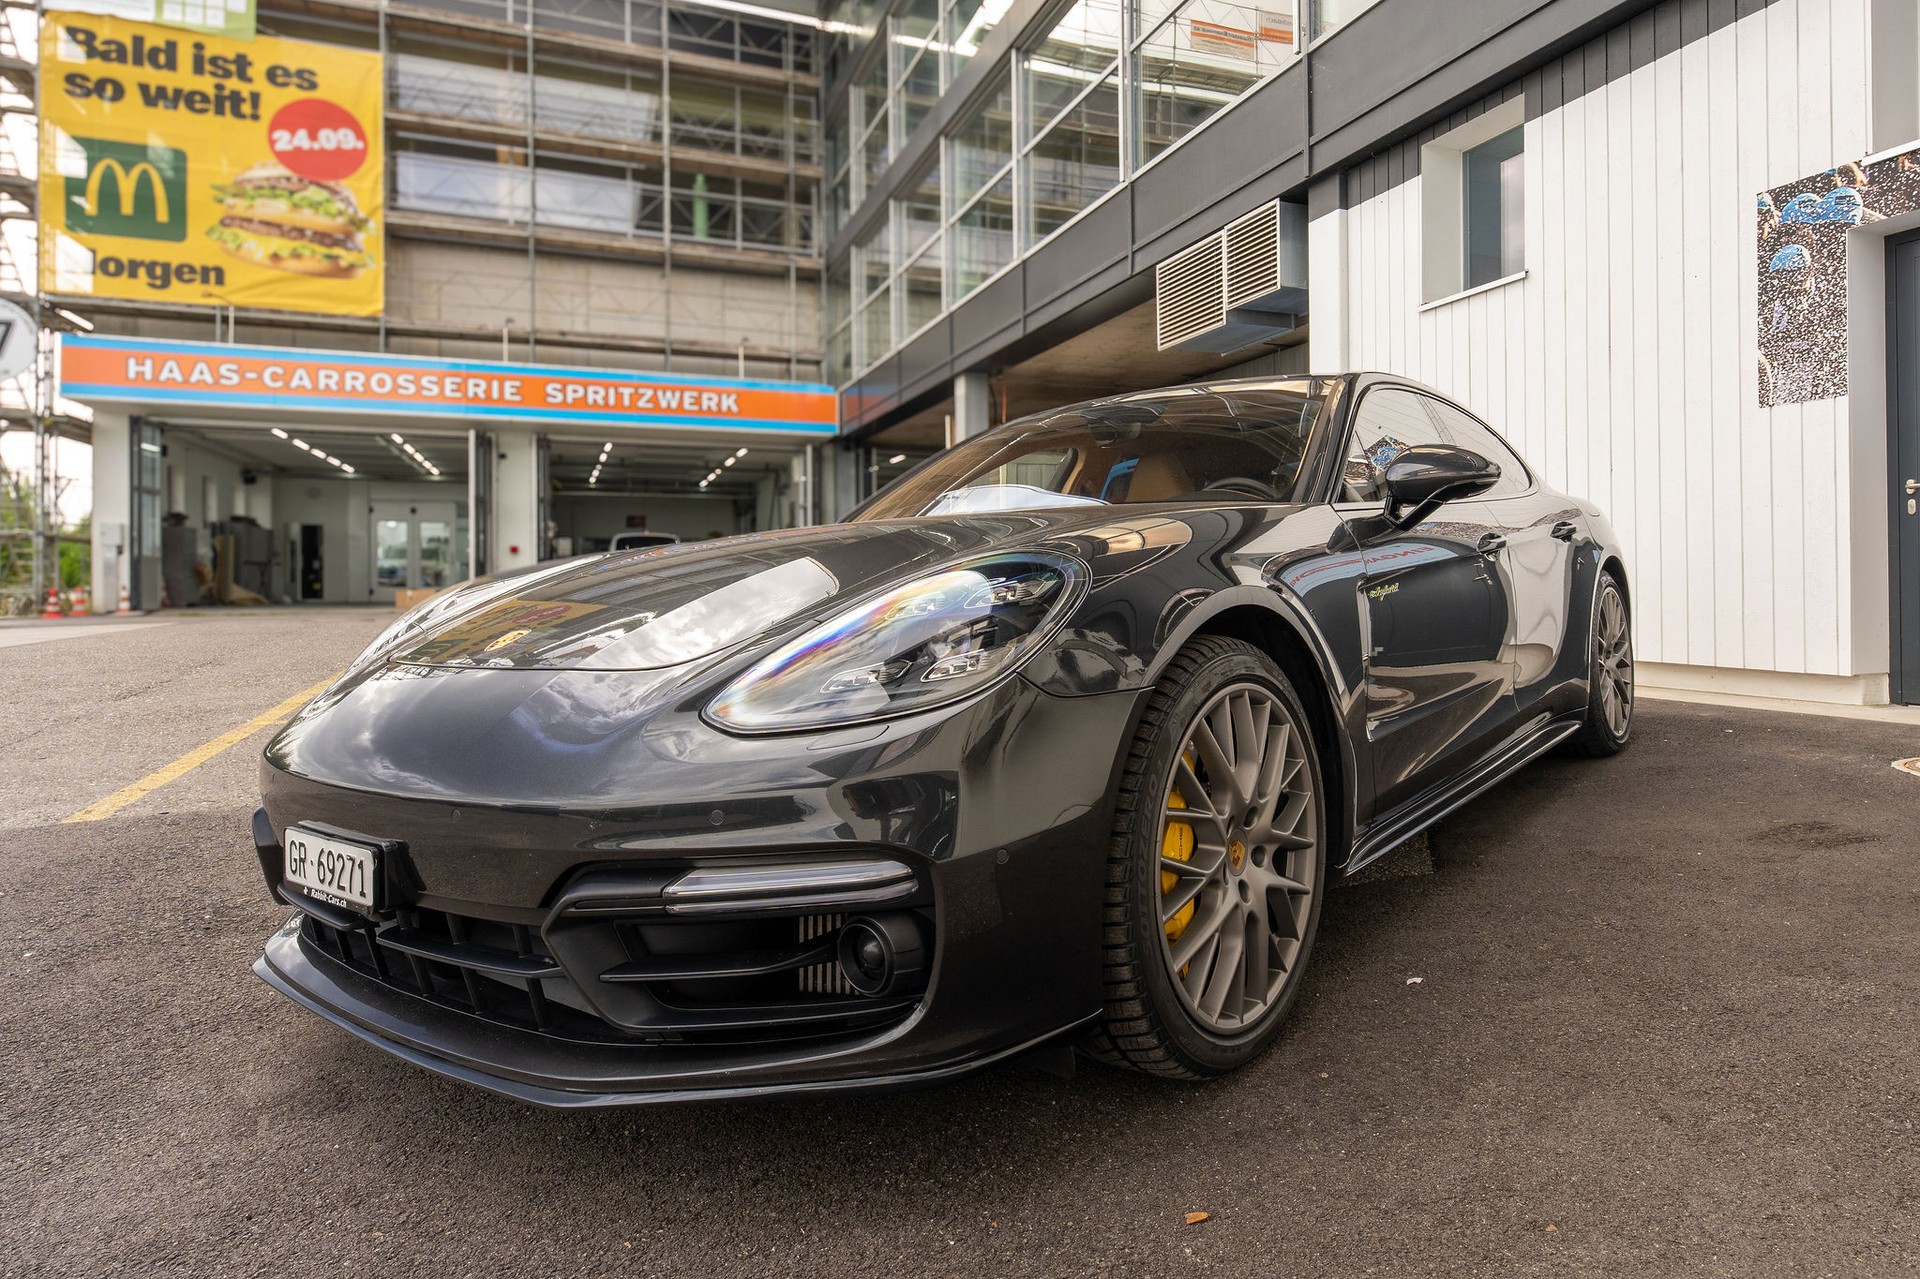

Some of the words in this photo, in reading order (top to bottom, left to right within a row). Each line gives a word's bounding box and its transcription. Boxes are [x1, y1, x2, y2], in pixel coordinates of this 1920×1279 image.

[64, 25, 178, 72] Bald
[191, 41, 253, 83] ist
[265, 64, 319, 91] es
[64, 72, 125, 102] so
[137, 82, 261, 121] weit!
[271, 127, 365, 151] 24.09.
[91, 248, 226, 290] orgen
[125, 356, 524, 403] HAAS-CARROSSERIE
[544, 382, 740, 414] SPRITZWERK
